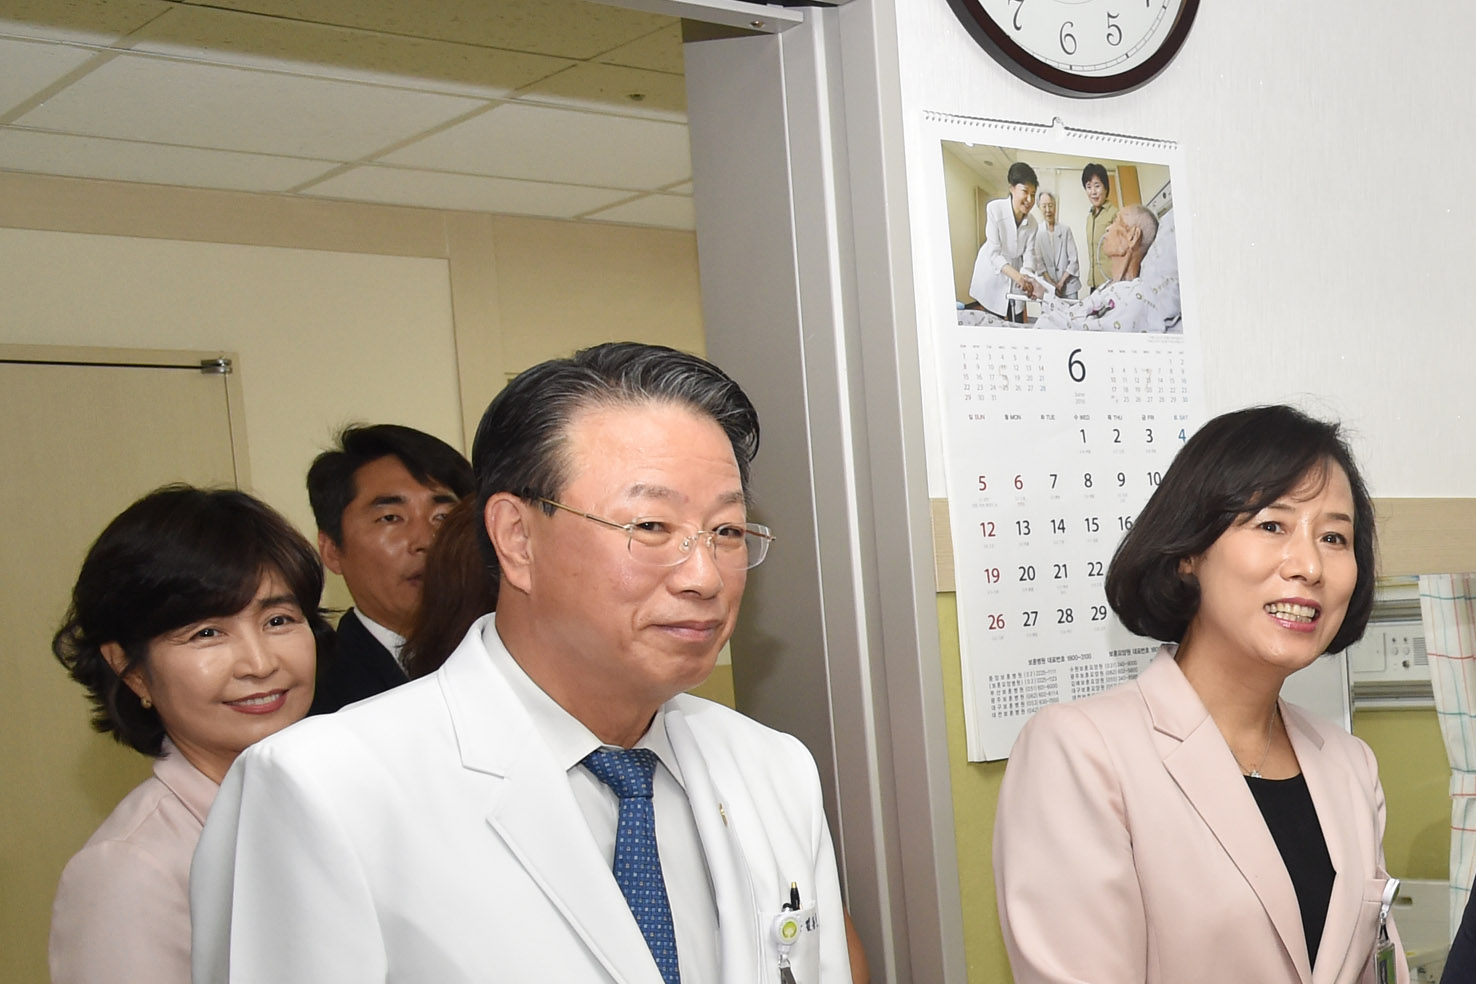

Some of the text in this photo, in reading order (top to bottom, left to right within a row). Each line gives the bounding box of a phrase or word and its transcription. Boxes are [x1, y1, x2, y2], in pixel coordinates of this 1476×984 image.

[1008, 0, 1024, 31] 7
[1060, 21, 1077, 55] 6
[1106, 12, 1122, 46] 5
[1068, 348, 1086, 382] 6
[1080, 428, 1187, 444] 1 2 3 4
[978, 471, 1162, 491] 5 6 7 8 9 10
[980, 516, 1134, 538] 12 13 14 15 16
[984, 562, 1104, 584] 19 20 21 22
[988, 606, 1108, 631] 26 27 28 29
